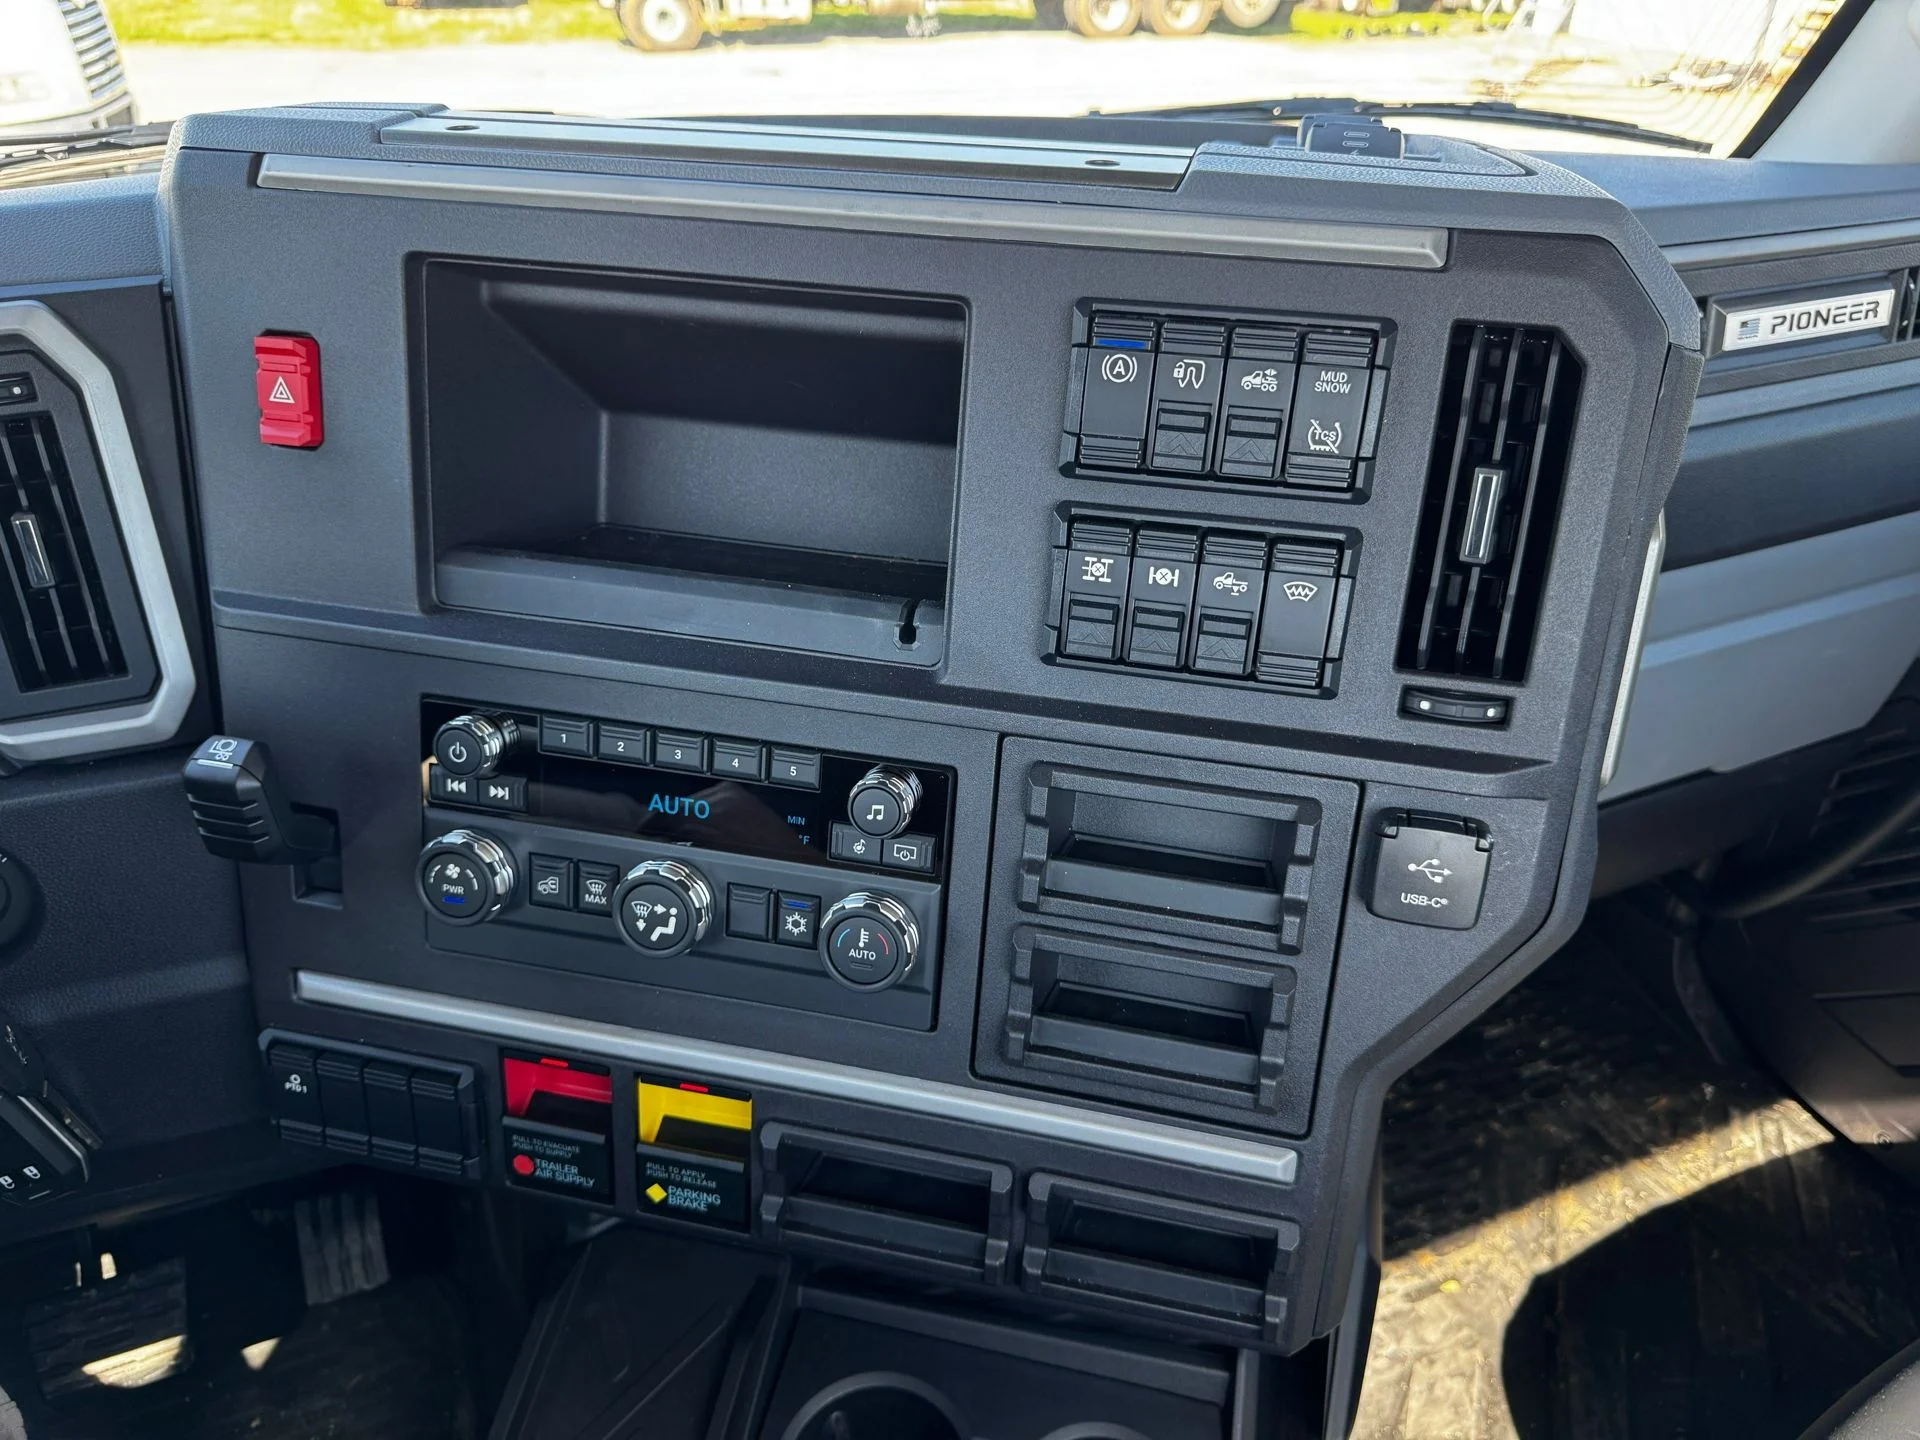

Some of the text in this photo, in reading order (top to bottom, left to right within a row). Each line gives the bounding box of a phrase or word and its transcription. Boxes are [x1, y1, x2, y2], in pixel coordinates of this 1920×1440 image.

[1771, 300, 1879, 334] PIONEER
[1320, 370, 1348, 382] MUD
[1314, 381, 1351, 394] SNOW
[560, 733, 567, 744] 1
[617, 742, 625, 752] 2
[674, 750, 682, 760] 3
[732, 758, 740, 768] 4
[790, 766, 798, 776] 5
[648, 793, 710, 819] AUTO
[787, 815, 806, 826] MIN
[442, 884, 464, 895] PWR
[585, 894, 607, 905] MAX
[848, 948, 876, 961] AUTO
[535, 1158, 579, 1175] TRAILER
[646, 1161, 666, 1172] PULL
[681, 1168, 706, 1180] APPLY
[535, 1168, 595, 1187] AIR SUPPLY
[646, 1167, 669, 1179] PUSH
[683, 1174, 717, 1189] RELEASE
[668, 1185, 721, 1205] PARKING
[668, 1194, 708, 1212] BRAKE
